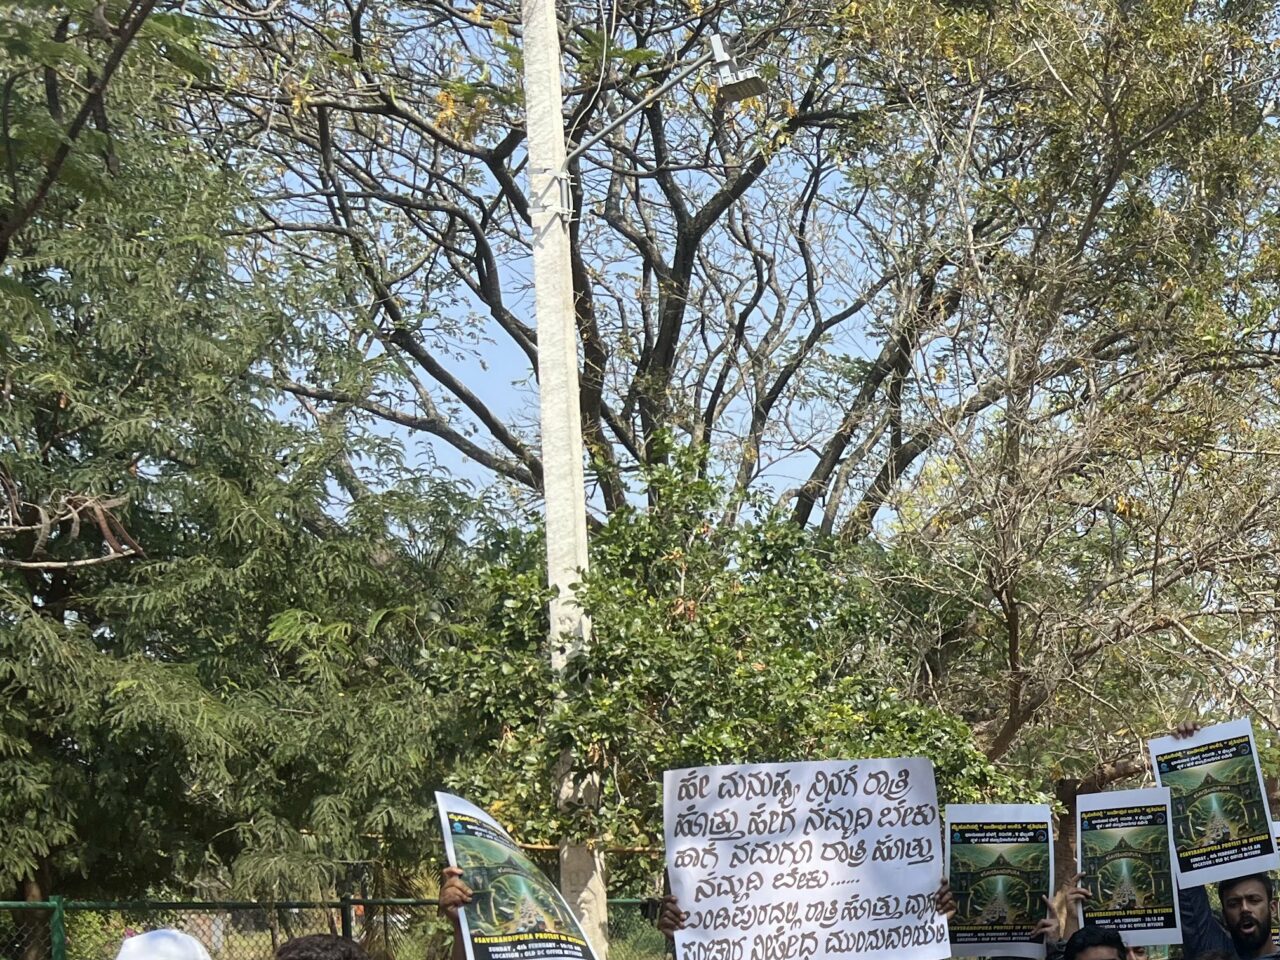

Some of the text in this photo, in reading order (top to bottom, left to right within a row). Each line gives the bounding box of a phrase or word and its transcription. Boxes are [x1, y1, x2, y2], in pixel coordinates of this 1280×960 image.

[678, 770, 710, 800] ಹೇ
[806, 765, 858, 802] ನಿನಗೆ
[863, 769, 913, 800] ರಾತ್ರಿ
[803, 803, 872, 840] ನೆಮ್ಮದಿ
[878, 800, 935, 827] ಬೇಕು
[821, 836, 869, 868] ರಾತ್ರಿ
[695, 868, 763, 904] ನೆಮ್ಮದಿ
[804, 899, 838, 928] ರಾತ್ರಿ
